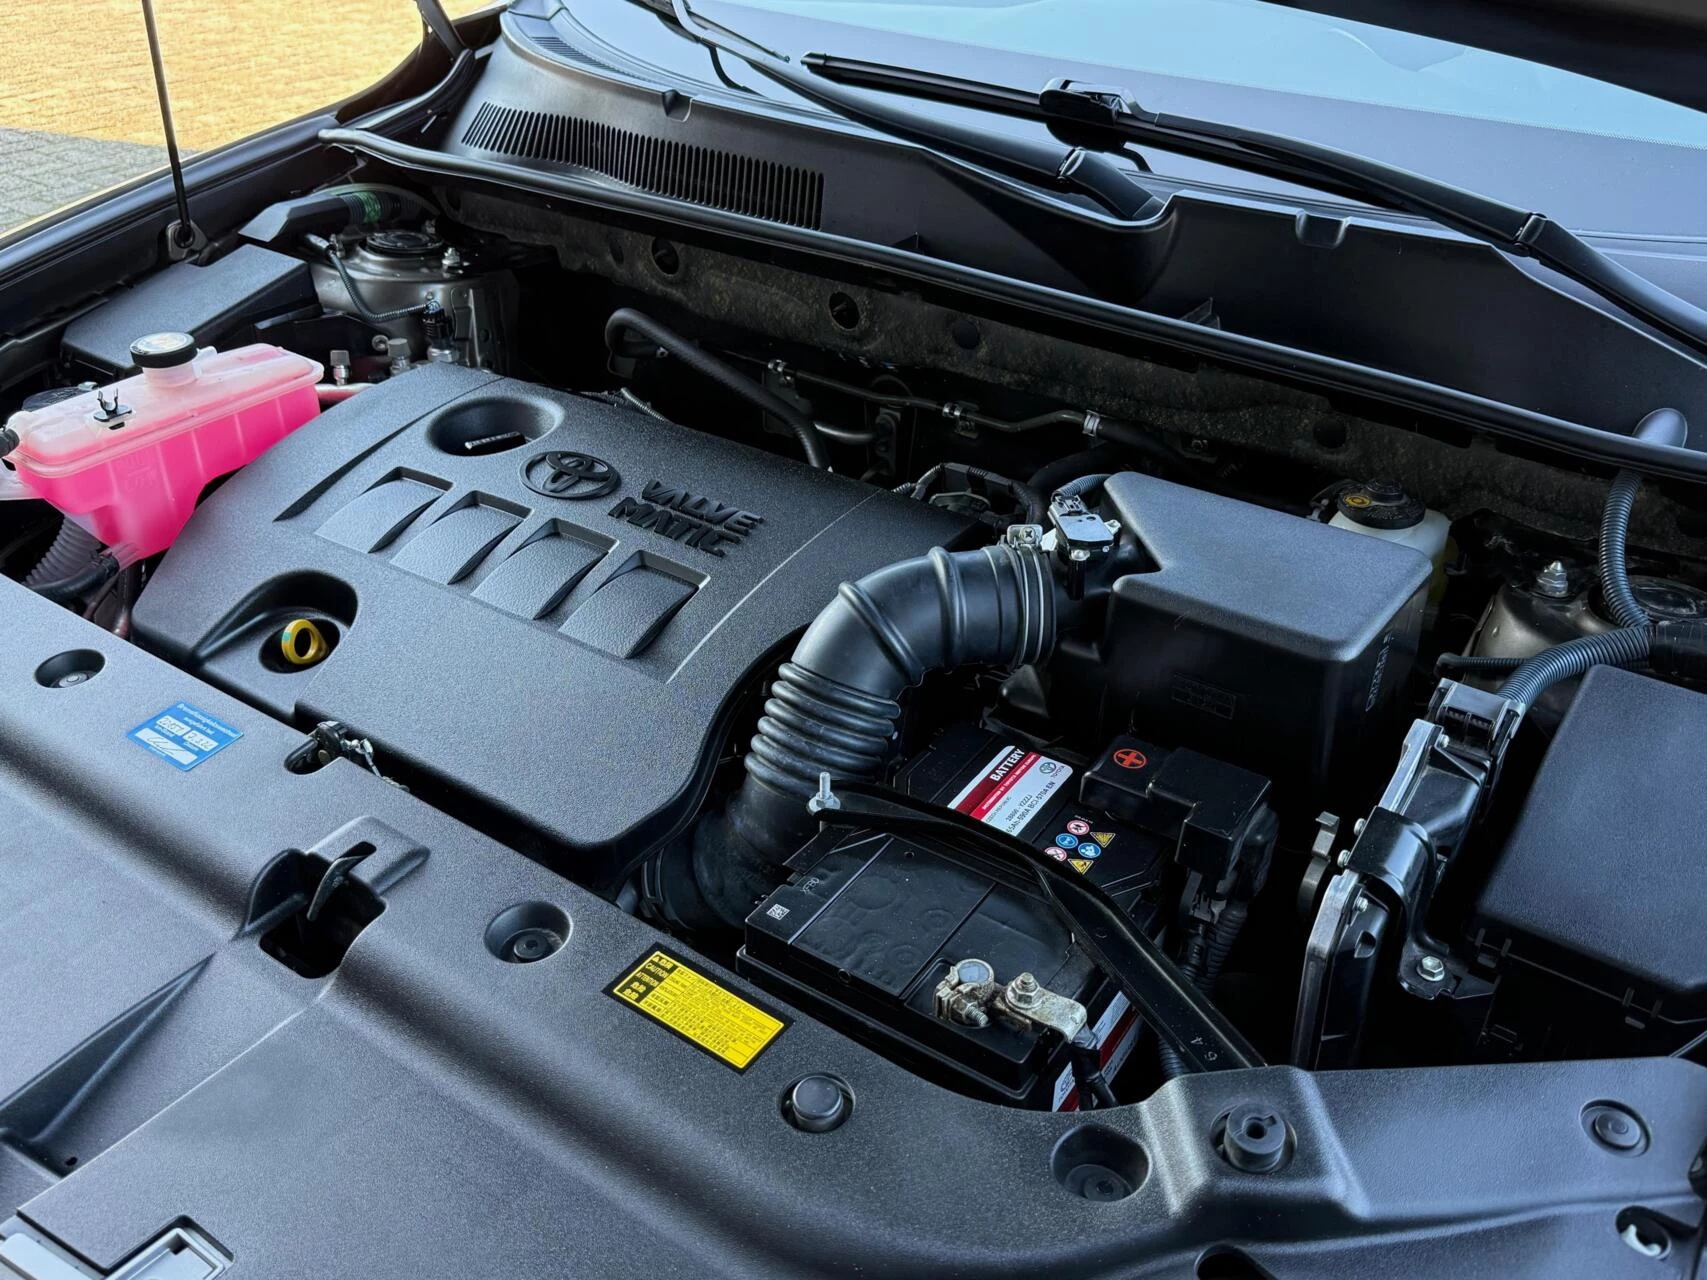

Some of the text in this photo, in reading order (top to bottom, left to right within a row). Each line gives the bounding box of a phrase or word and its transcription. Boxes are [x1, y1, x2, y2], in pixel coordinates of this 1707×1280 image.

[642, 480, 765, 537] VALVE
[607, 496, 741, 558] MATIC
[989, 747, 1025, 782] BATTERY
[1050, 765, 1065, 779] TOYOTA
[636, 971, 660, 988] ATTENTION
[645, 962, 670, 979] CAUTION
